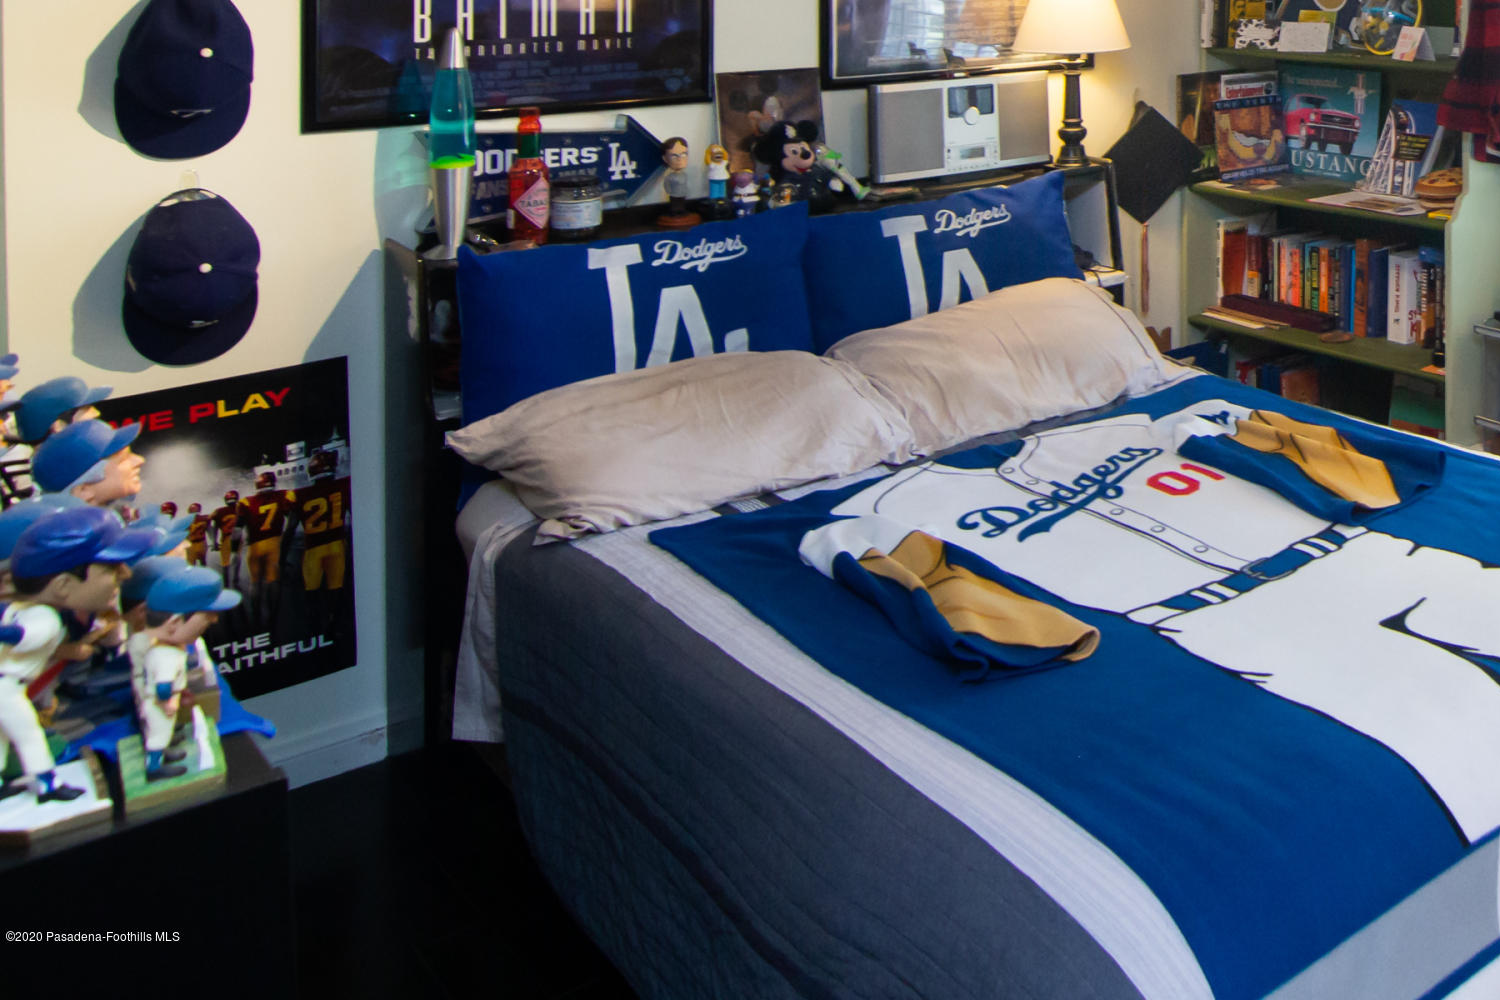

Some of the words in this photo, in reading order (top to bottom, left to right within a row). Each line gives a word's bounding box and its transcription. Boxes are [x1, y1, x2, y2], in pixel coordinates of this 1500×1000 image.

[577, 36, 633, 51] MOVIE
[608, 142, 637, 180] LA
[1290, 150, 1371, 177] USTANG
[933, 203, 1013, 238] Dodgers
[650, 234, 748, 273] Dodgers
[189, 387, 291, 424] PLAY
[956, 445, 1165, 542] Dodgers
[1146, 463, 1227, 496] 01
[258, 502, 278, 531] 7
[303, 492, 343, 534] 21
[213, 632, 271, 658] THE
[217, 635, 335, 675] AITHFUL
